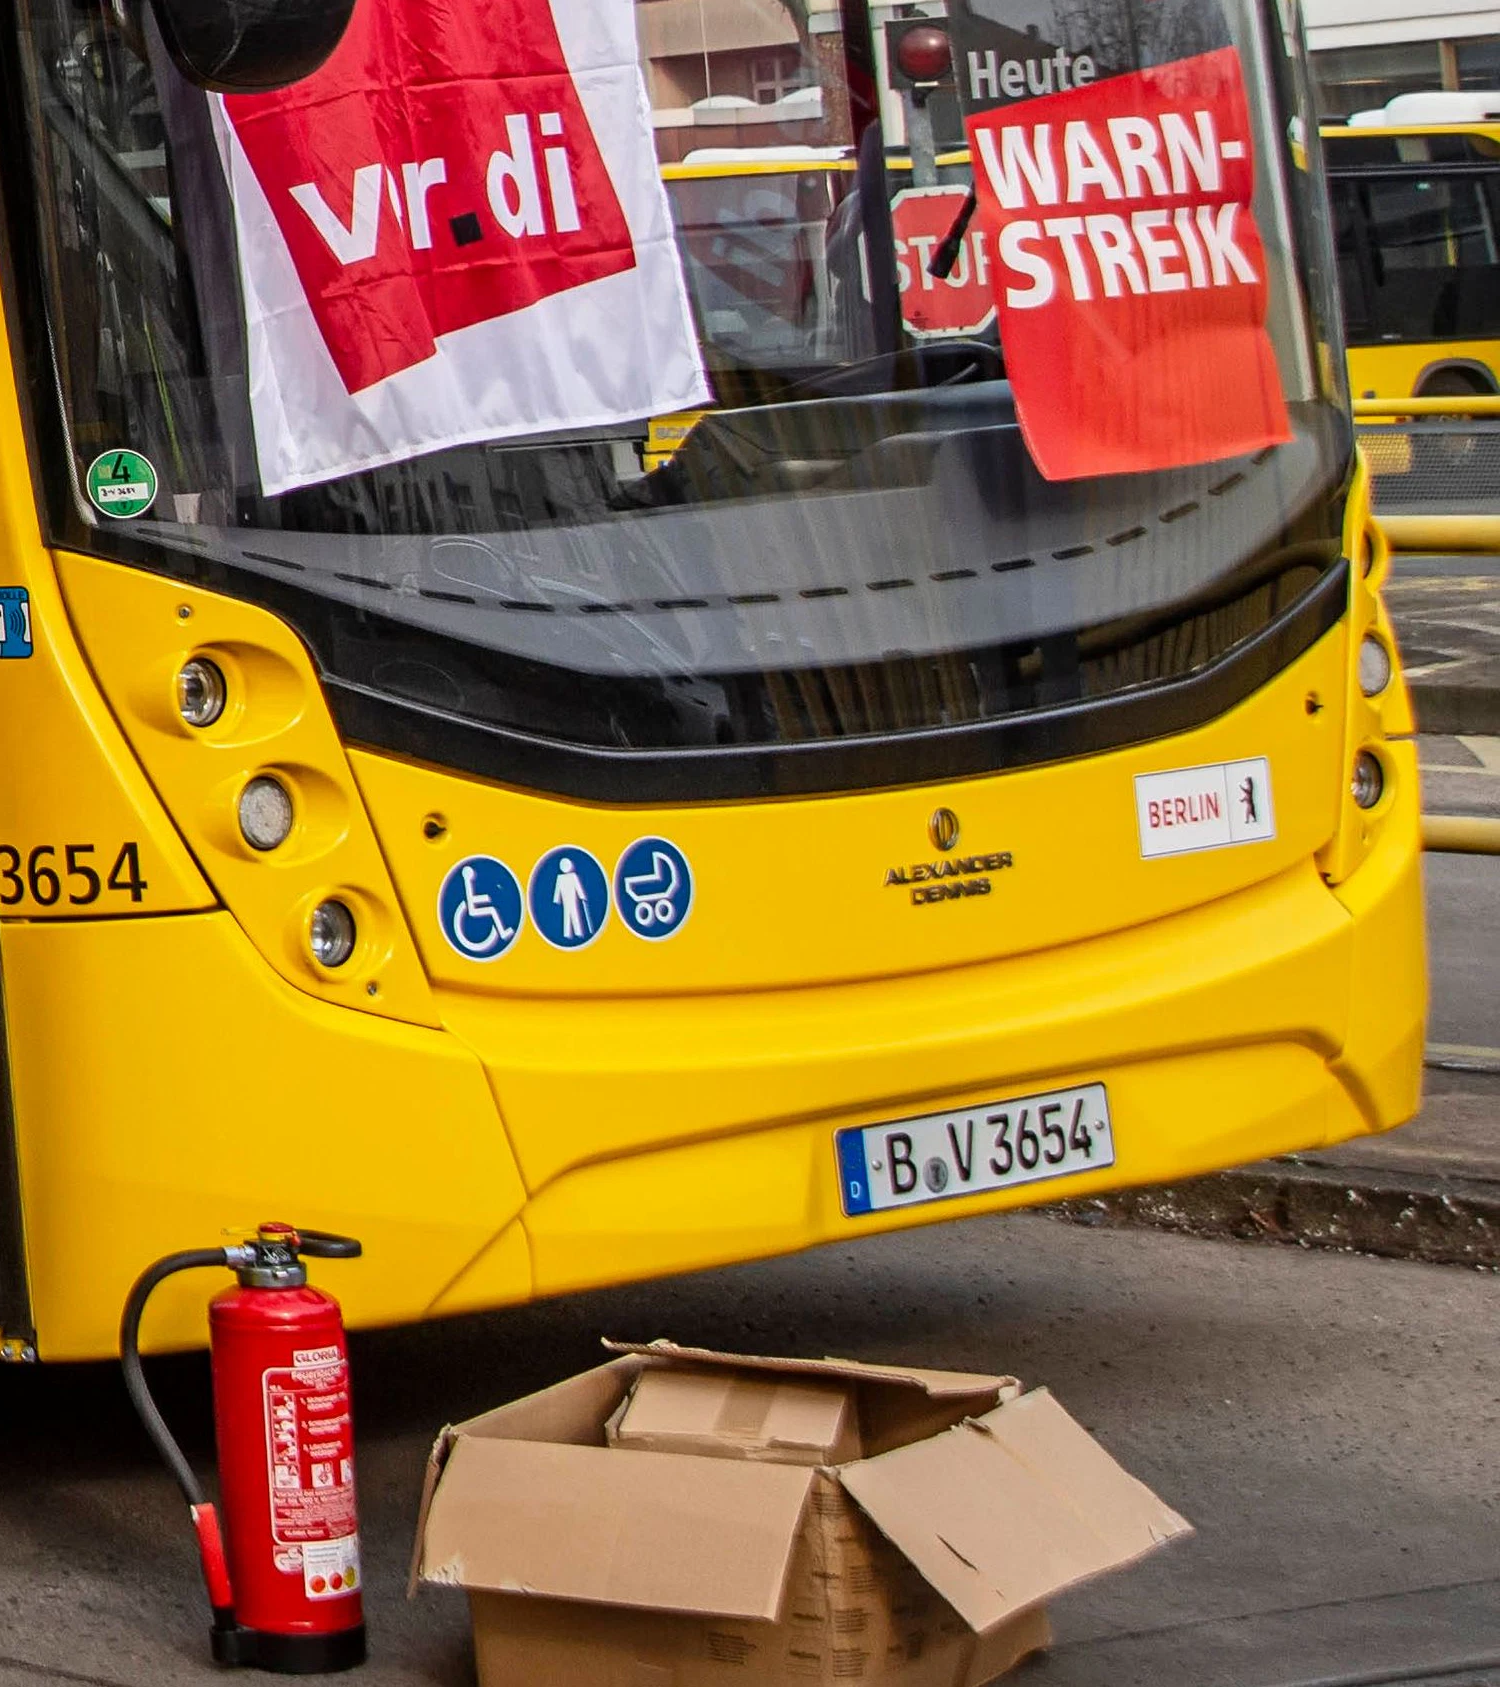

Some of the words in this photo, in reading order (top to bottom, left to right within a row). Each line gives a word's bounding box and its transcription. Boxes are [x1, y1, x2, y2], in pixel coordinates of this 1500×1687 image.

[967, 48, 1097, 102] Heute
[975, 111, 1246, 211] WARN-
[288, 112, 582, 267] vr.di
[998, 202, 1257, 310] STREIK
[111, 453, 131, 483] 4
[1149, 791, 1221, 830] BERLIN
[884, 851, 1013, 888] ALEXANDER
[911, 877, 992, 906] DENNIS
[885, 1132, 918, 1195] B
[948, 1119, 975, 1182] V
[992, 1097, 1093, 1177] 3654
